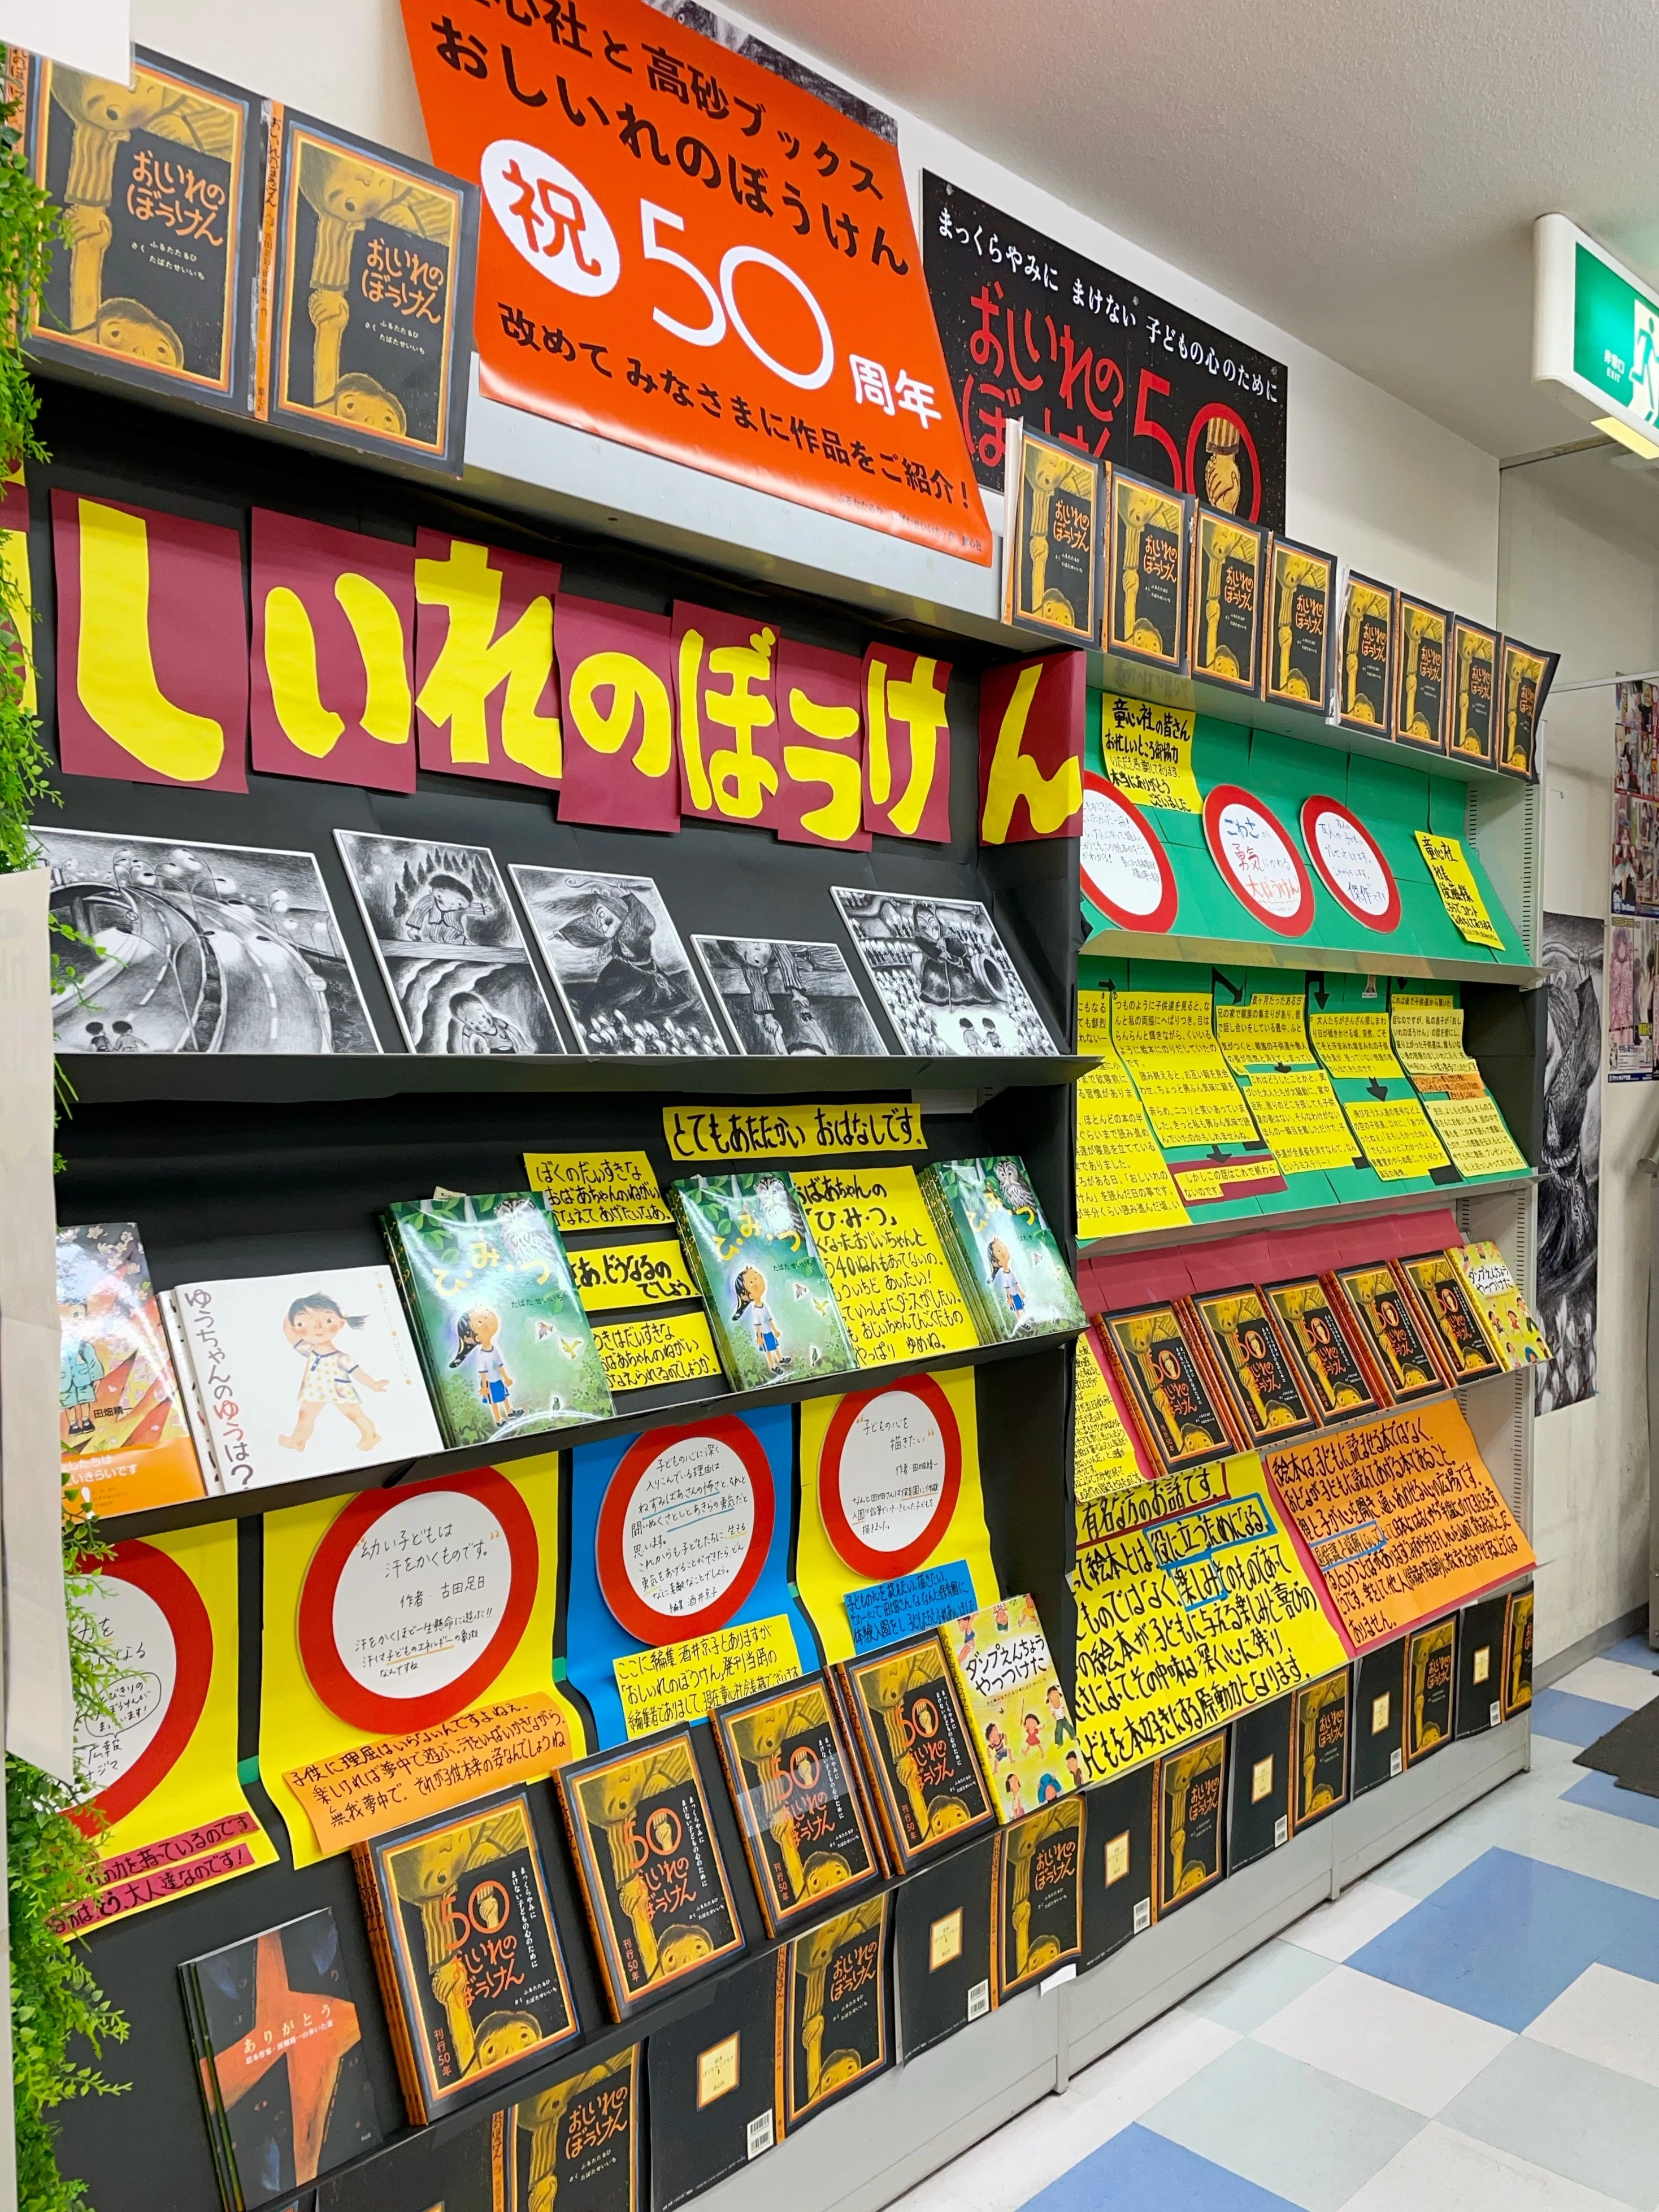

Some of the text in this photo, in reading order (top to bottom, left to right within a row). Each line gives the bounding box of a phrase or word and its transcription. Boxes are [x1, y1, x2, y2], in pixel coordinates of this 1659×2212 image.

[473, 0, 883, 200] 心社と高砂ブックス
[432, 15, 909, 276] おしいれのぼうけん
[132, 149, 226, 211] おしいれの
[127, 182, 223, 247] ぼうけん
[502, 158, 602, 278] 祝
[366, 237, 444, 289] おしいれの
[362, 269, 441, 324] ぼうけん
[640, 198, 835, 390] 50
[849, 353, 942, 431] 周年
[938, 208, 1278, 403] まっくらやみに まけない 子どもの心のために
[969, 280, 1124, 420] おしいれの
[1604, 349, 1625, 374] 非常口
[1607, 366, 1621, 383] EXIT
[1053, 522, 1089, 552] ぼうけん
[1055, 499, 1089, 530] おしいれの
[1144, 554, 1177, 583] ぼうけん
[1145, 535, 1178, 562] おしいれの
[1224, 584, 1253, 611] ぼうけん
[1226, 566, 1254, 593] おしいれの
[0, 457, 1084, 844] しいれのぼうけん
[1112, 697, 1191, 742] 童心社の皆さん
[673, 1111, 806, 1157] とてもあたたかい
[536, 1159, 642, 1184] ぼくのだいすきな
[1076, 1171, 1168, 1187] ろがある日、「おしいれの
[380, 1662, 419, 1678] なんですね
[965, 1635, 1045, 1682] ダンプえんちょう
[975, 1656, 1046, 1697] やっつけた
[1035, 1864, 1075, 1891] ぼうけん
[1036, 1841, 1076, 1871] おしいれの
[622, 1939, 640, 1982] 刊行50年
[833, 1941, 878, 1979] おしいれの
[830, 1964, 876, 2002] ぼうけん
[244, 2004, 331, 2055] ありがとう
[433, 2028, 452, 2077] 刊行50年
[568, 2086, 628, 2133] おしいれの
[565, 2107, 628, 2160] ぼうけん
